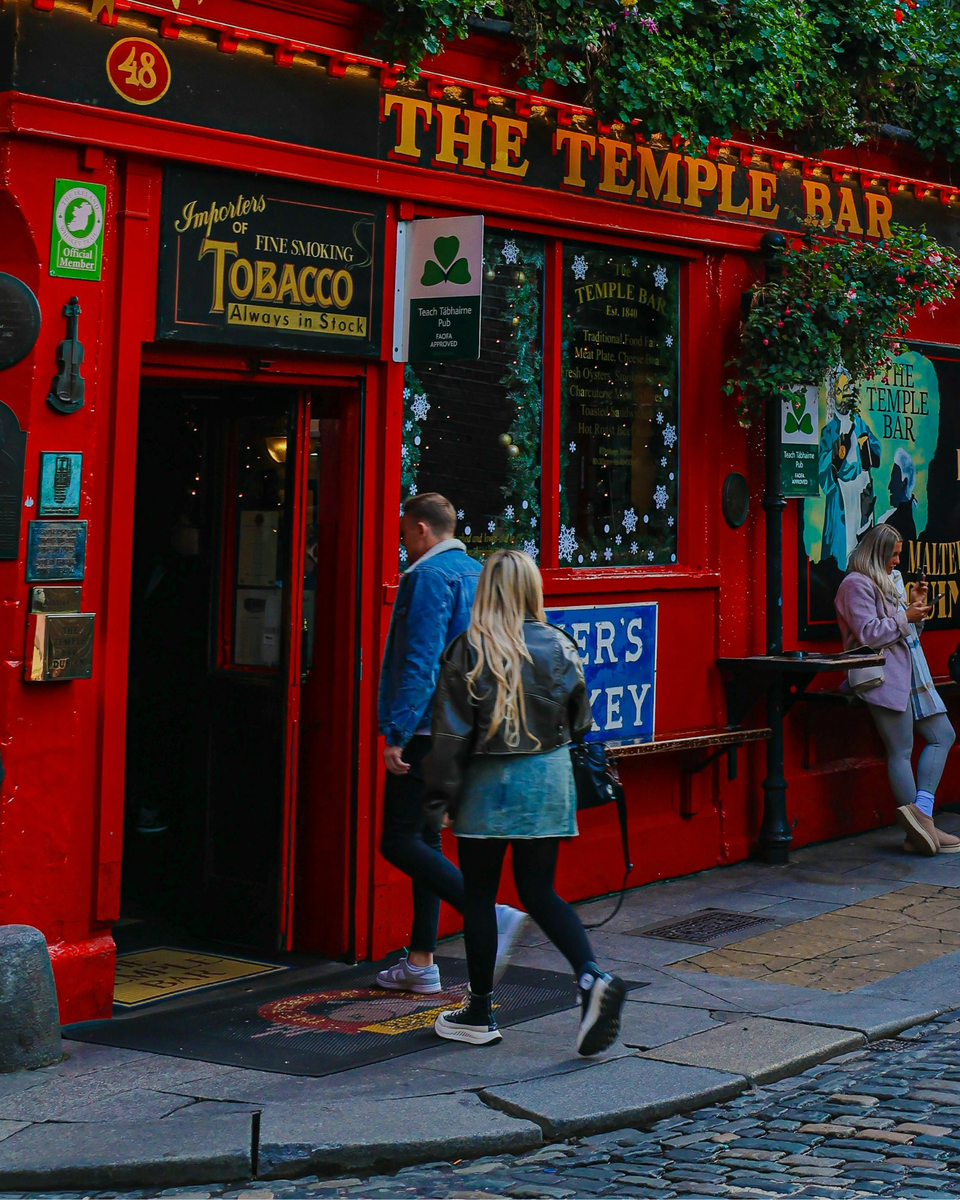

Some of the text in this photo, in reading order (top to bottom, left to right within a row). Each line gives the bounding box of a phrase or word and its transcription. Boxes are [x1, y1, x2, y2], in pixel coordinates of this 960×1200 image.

[118, 46, 157, 89] 48
[381, 93, 895, 241] THE TEMPLE BAR
[174, 194, 266, 237] Importers
[232, 221, 248, 234] OF
[63, 247, 93, 259] Official
[255, 234, 353, 262] FINE SMOKING
[60, 257, 95, 269] Member
[198, 237, 353, 313] TOBACCO
[615, 263, 631, 277] The
[418, 306, 472, 316] Teach Tábhairne
[575, 282, 667, 314] TEMPLE BAR
[230, 304, 364, 333] Always in Stock
[438, 318, 451, 327] Pub
[606, 305, 638, 318] Est. 1840
[583, 329, 623, 344] Traditional
[575, 346, 594, 359] Meat
[885, 362, 915, 388] HE
[866, 387, 929, 415] TEMPLE
[883, 414, 916, 442] BAR
[795, 460, 804, 468] Pub
[560, 617, 643, 665] ER'S
